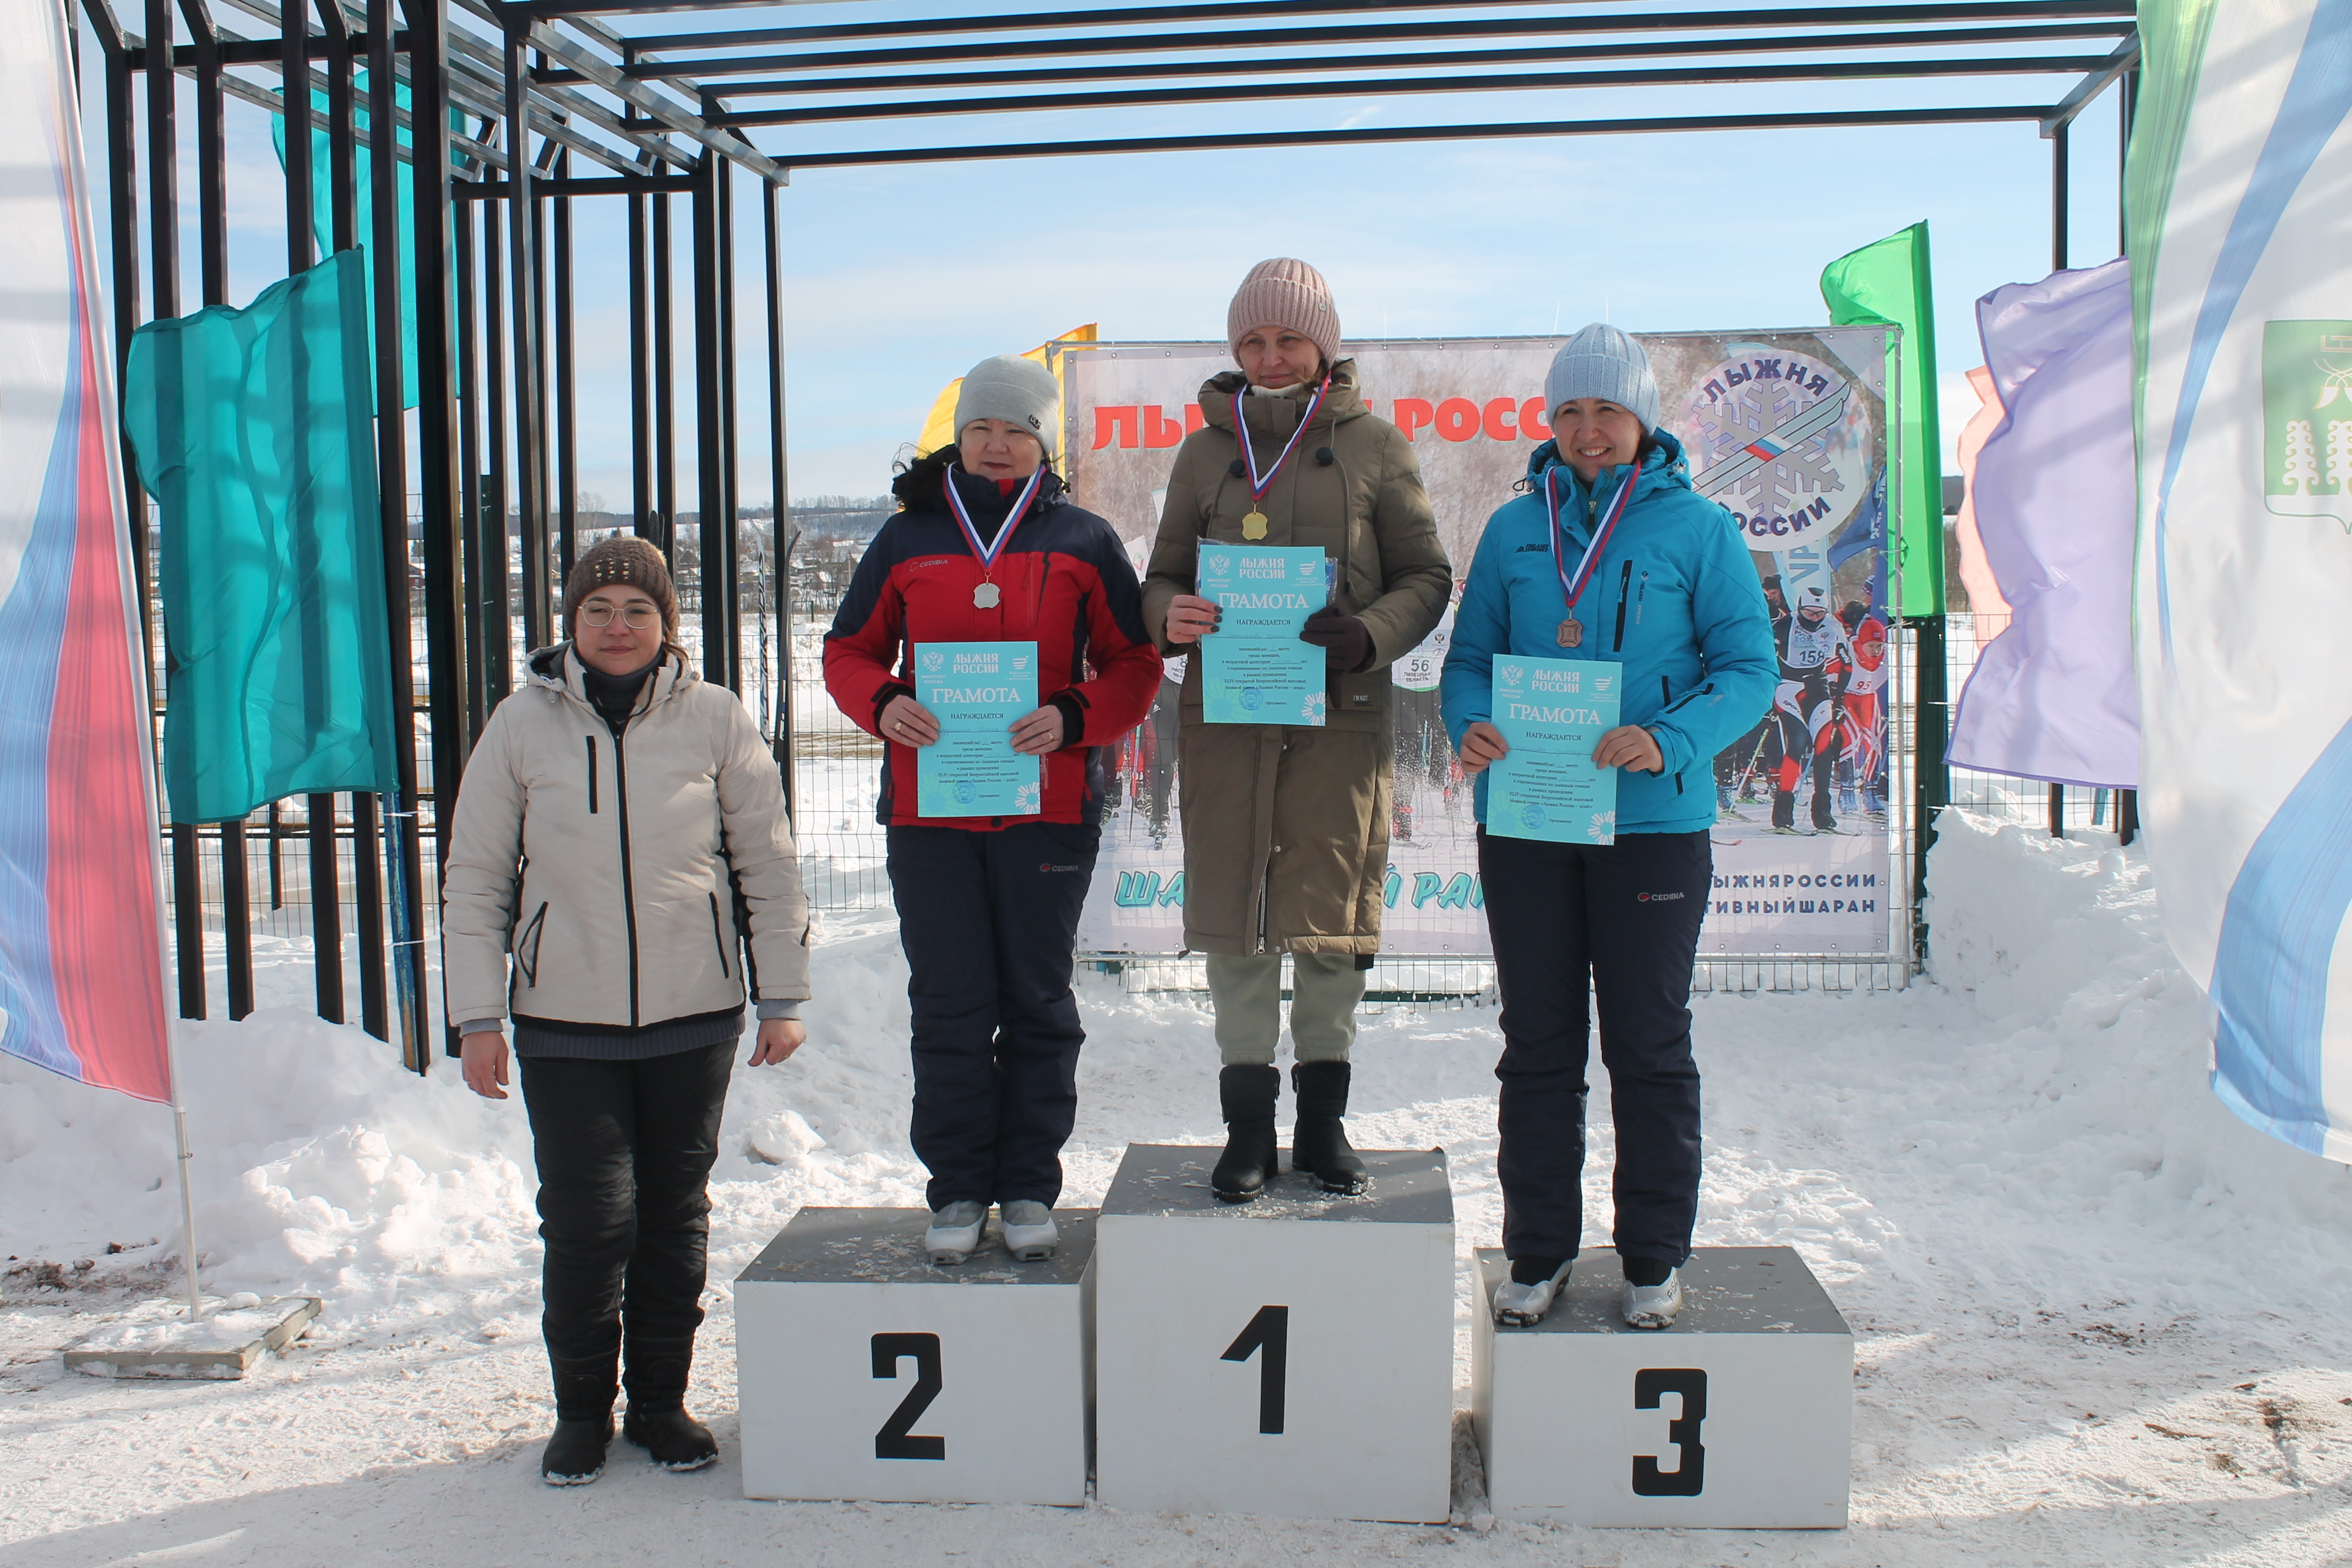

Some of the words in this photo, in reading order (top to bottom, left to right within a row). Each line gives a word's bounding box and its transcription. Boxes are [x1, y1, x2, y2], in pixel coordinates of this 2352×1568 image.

[1703, 359, 1828, 402] ЛЫЖНЯ
[1394, 396, 1553, 443] РОСС
[1240, 558, 1285, 568] ЛЫЖНЯ
[1789, 545, 1820, 585] УР
[1239, 569, 1286, 579] РОССИИ
[1218, 593, 1309, 609] ГРАМОТА
[954, 653, 998, 663] ЛЫЖНЯ
[1799, 650, 1825, 663] 158
[954, 663, 998, 673] РОССИИ
[1411, 659, 1430, 672] 56
[1533, 669, 1580, 682] ЛЫЖНЯ
[1532, 680, 1580, 693] РОССИИ
[932, 688, 1021, 703] ГРАМОТА
[1509, 703, 1602, 725] ГРАМОТА
[1526, 731, 1581, 741] НАГРАЖДАЕТСЯ
[1713, 874, 1875, 888] ЫЖНЯРОССИИ
[1652, 892, 1684, 901] CEDIBIA
[1667, 1270, 1678, 1303] FISC
[1219, 1305, 1289, 1435] 1
[871, 1332, 946, 1461] 2
[1632, 1369, 1708, 1497] 3
